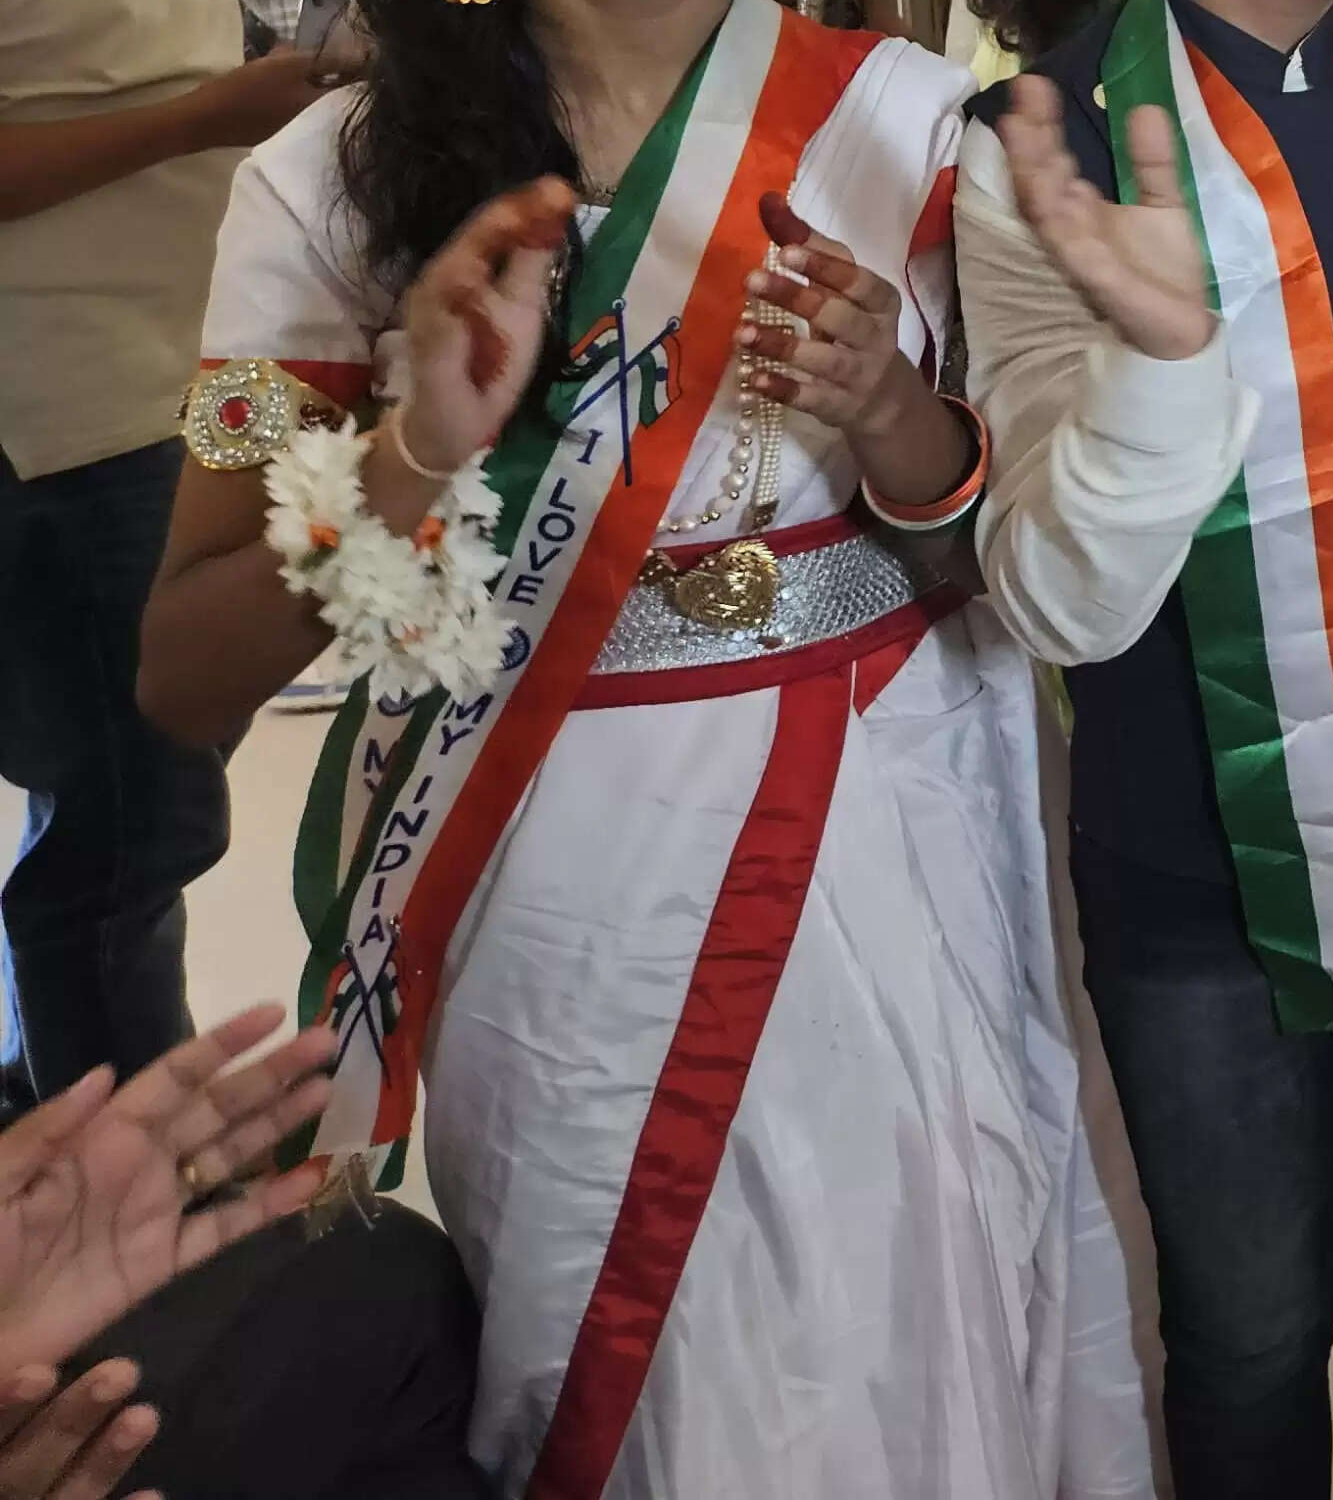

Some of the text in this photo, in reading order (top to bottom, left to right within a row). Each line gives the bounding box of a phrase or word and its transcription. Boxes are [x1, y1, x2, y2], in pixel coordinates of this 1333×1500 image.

[358, 428, 604, 949] I LOVE MY INDIA
